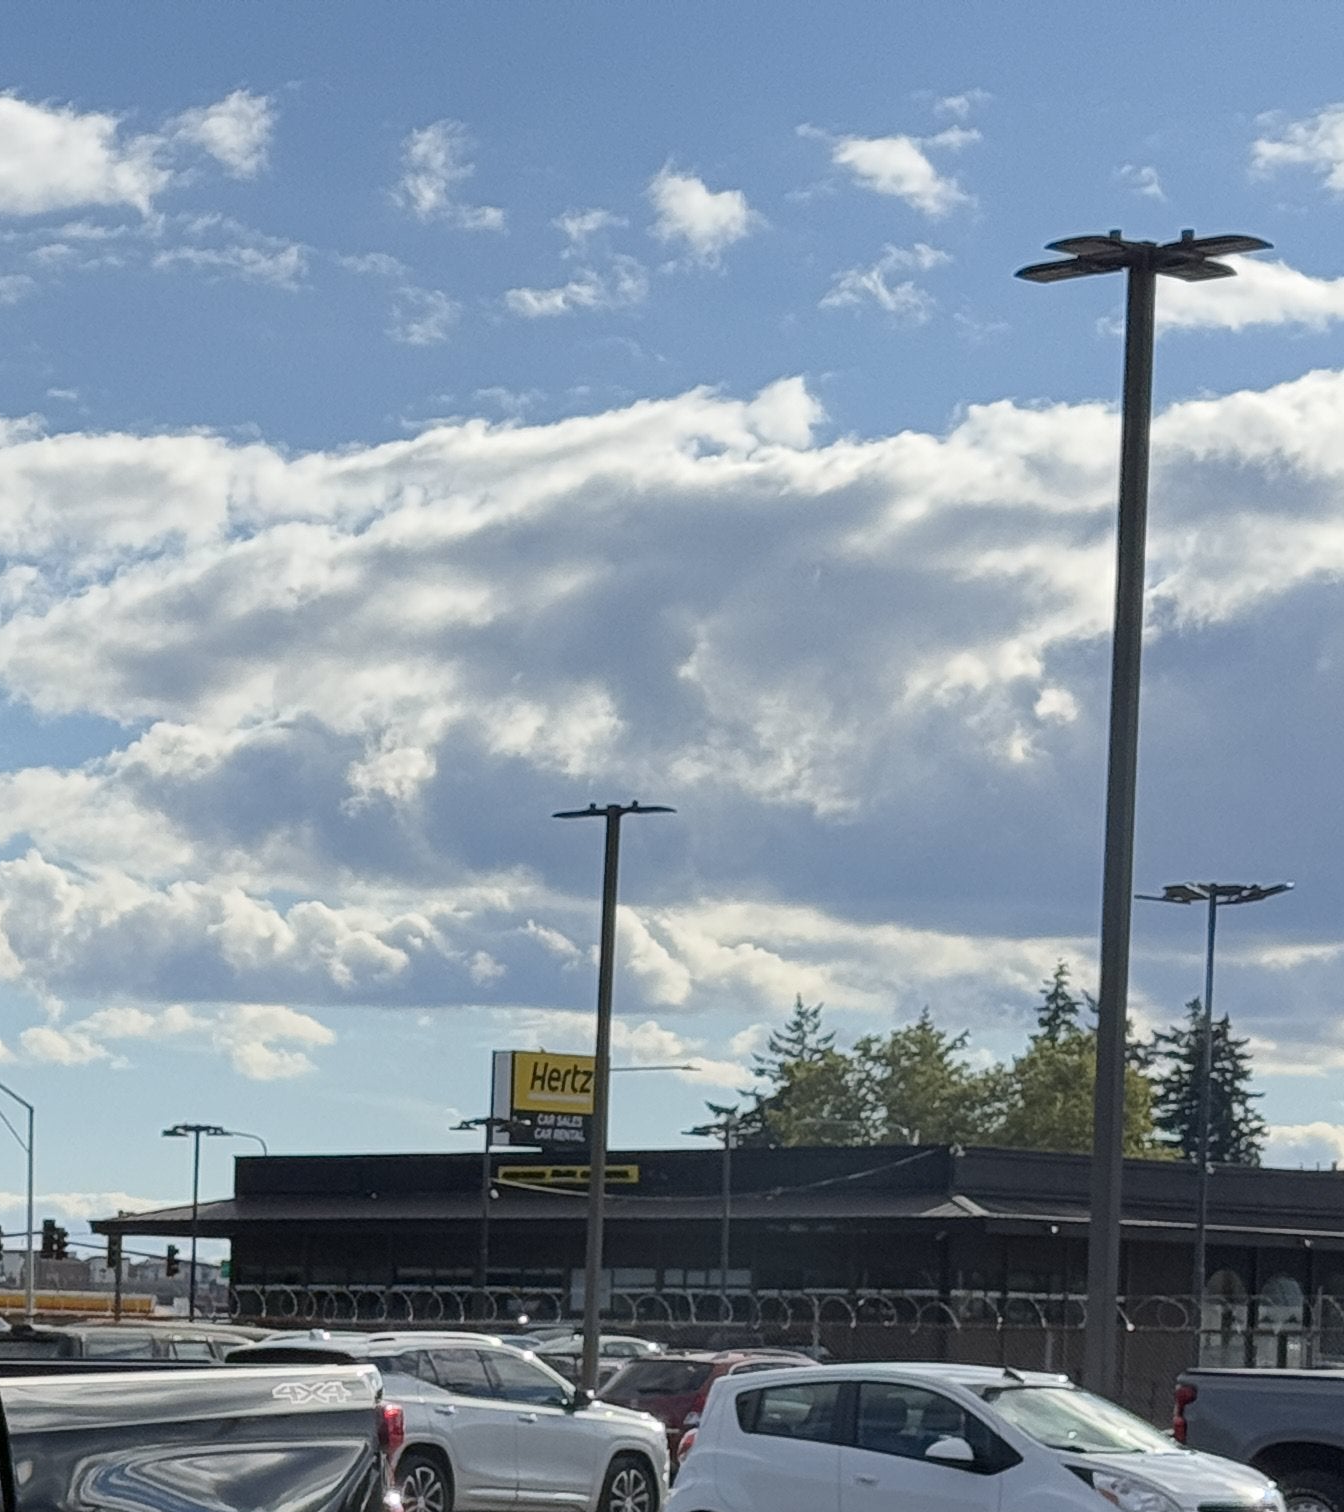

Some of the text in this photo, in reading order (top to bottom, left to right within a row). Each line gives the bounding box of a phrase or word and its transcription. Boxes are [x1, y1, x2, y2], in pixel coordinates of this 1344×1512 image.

[529, 1061, 593, 1094] Hertz
[537, 1113, 583, 1128] CAR SALES
[534, 1127, 586, 1143] CAR RENTAL
